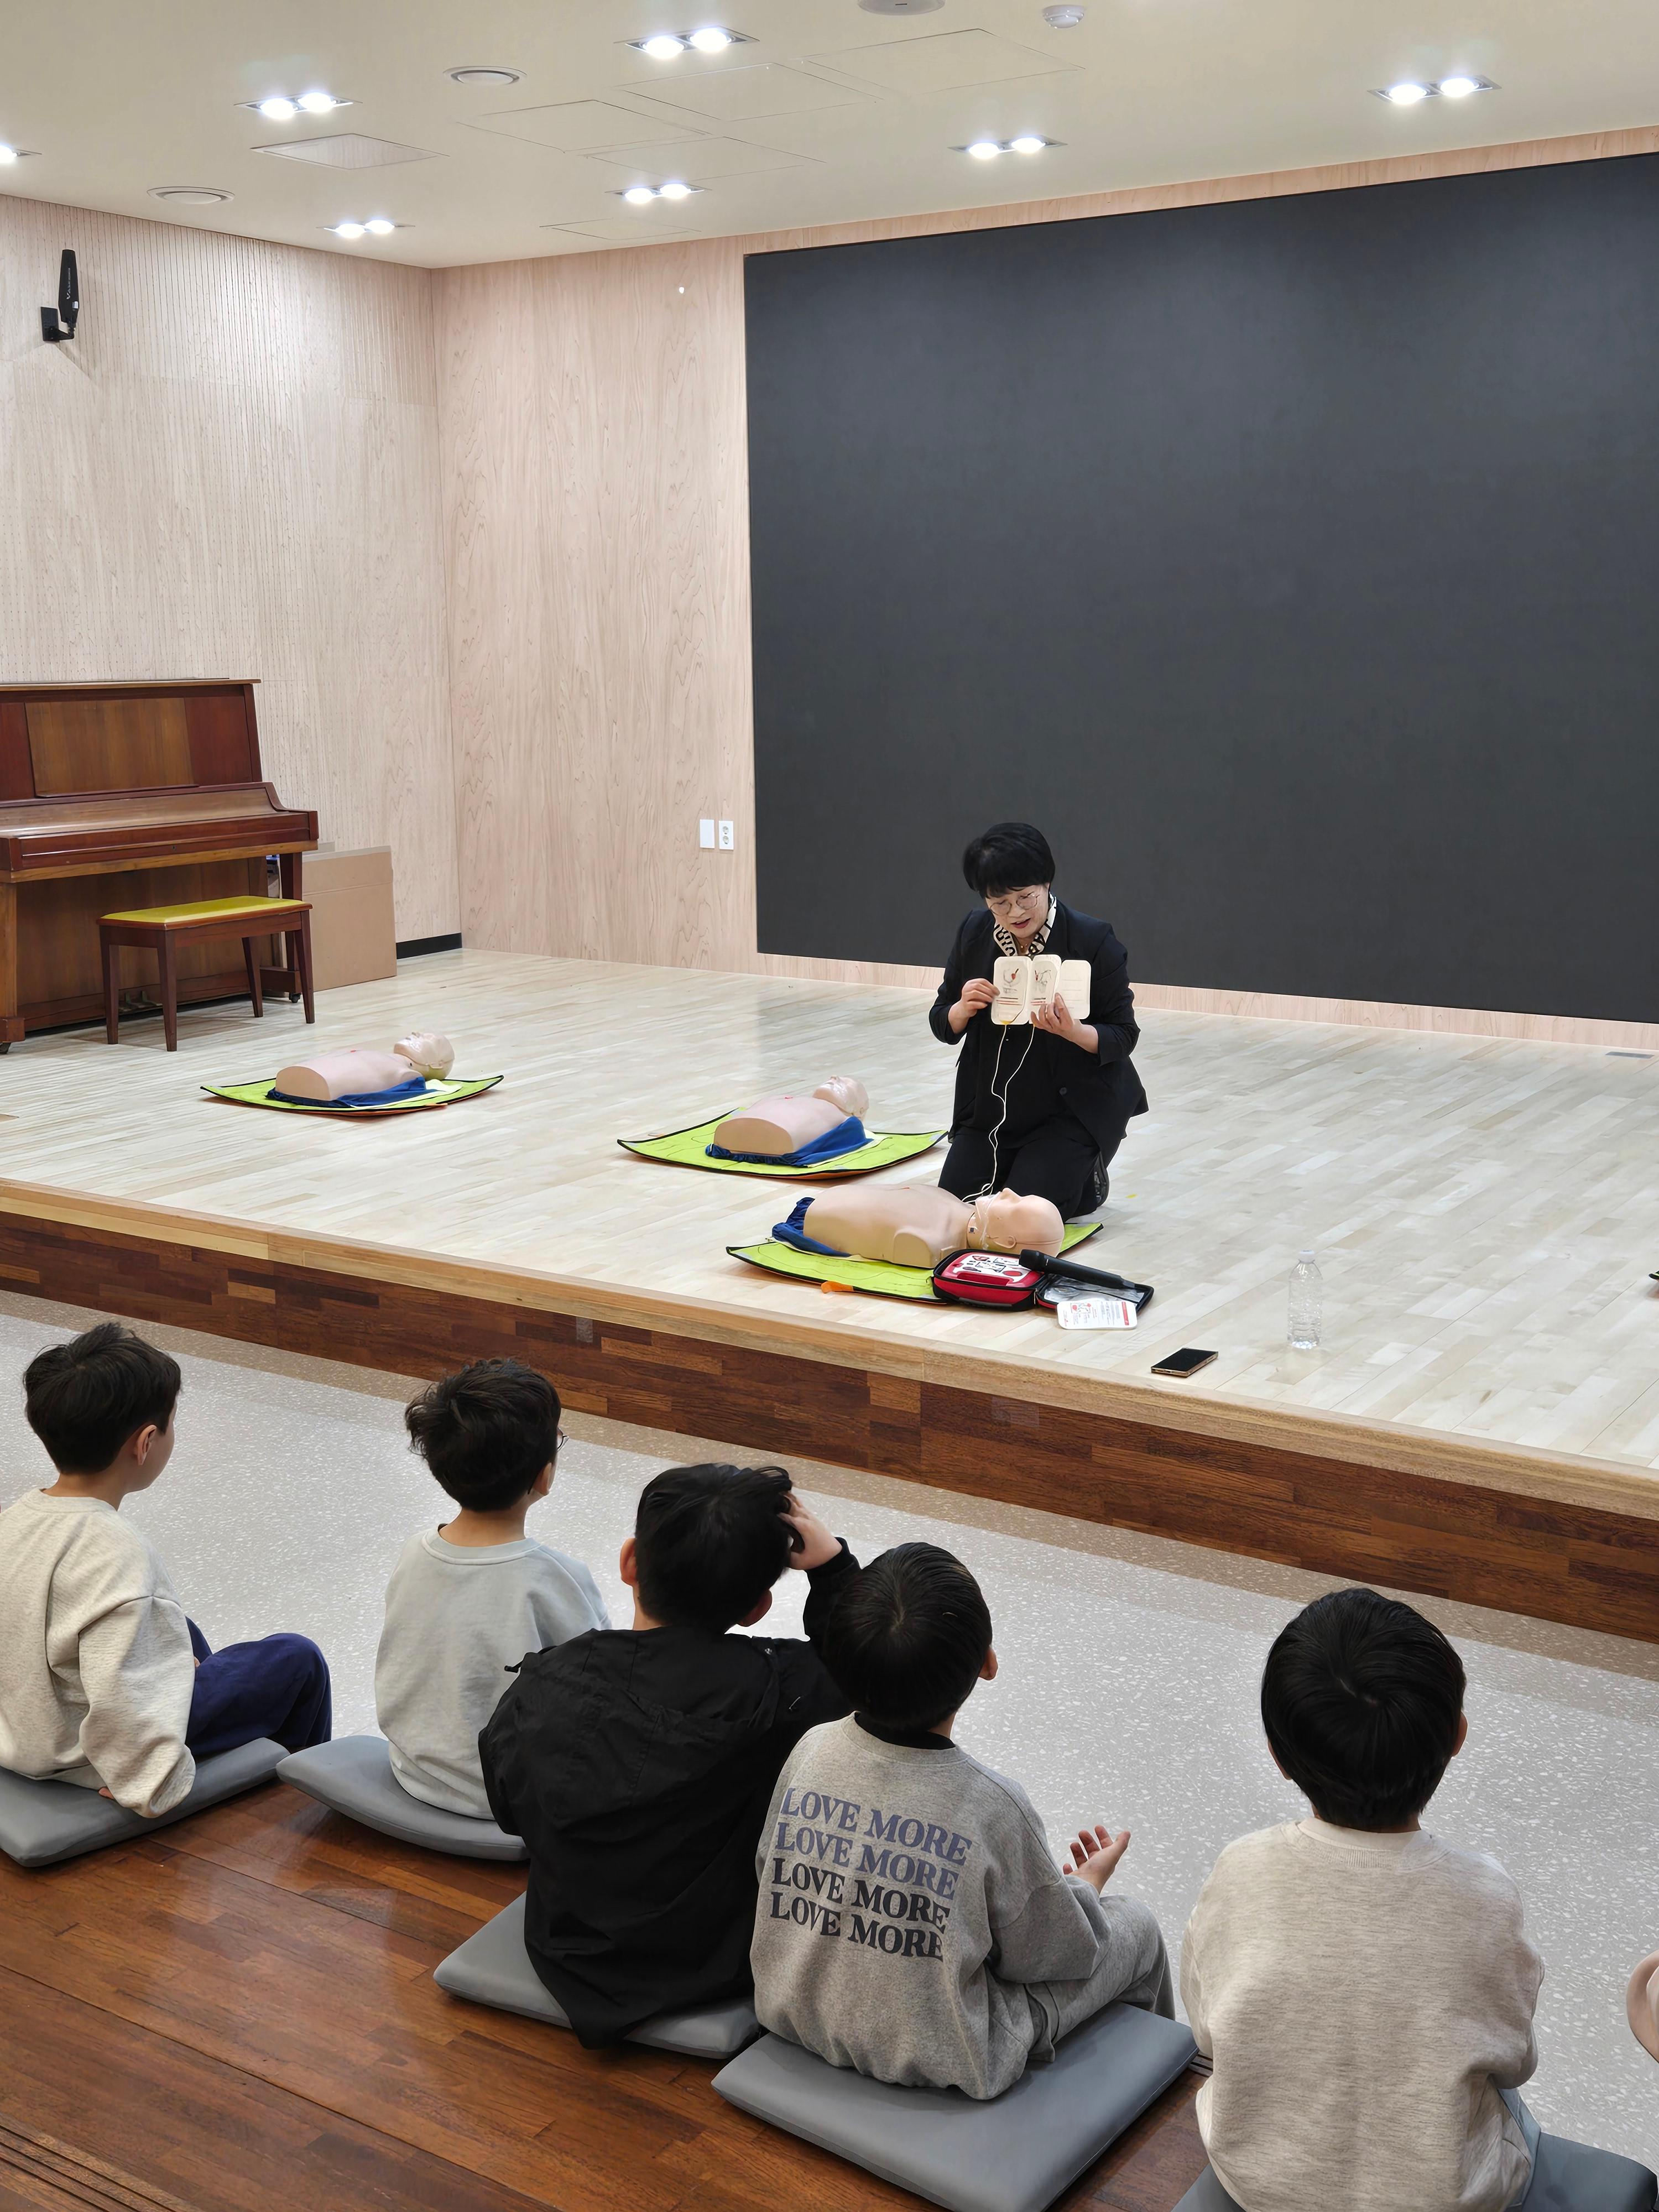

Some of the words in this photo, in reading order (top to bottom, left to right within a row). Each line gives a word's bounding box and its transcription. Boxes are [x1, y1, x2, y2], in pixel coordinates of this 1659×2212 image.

[775, 1822, 853, 1867] LOVE
[855, 1844, 959, 1900] MORE
[781, 1788, 860, 1832] LOVE
[864, 1809, 972, 1866] MORE
[770, 1892, 841, 1936] LOVE
[848, 1914, 943, 1962] MORE
[772, 1858, 845, 1904] LOVE
[851, 1880, 951, 1934] MORE
